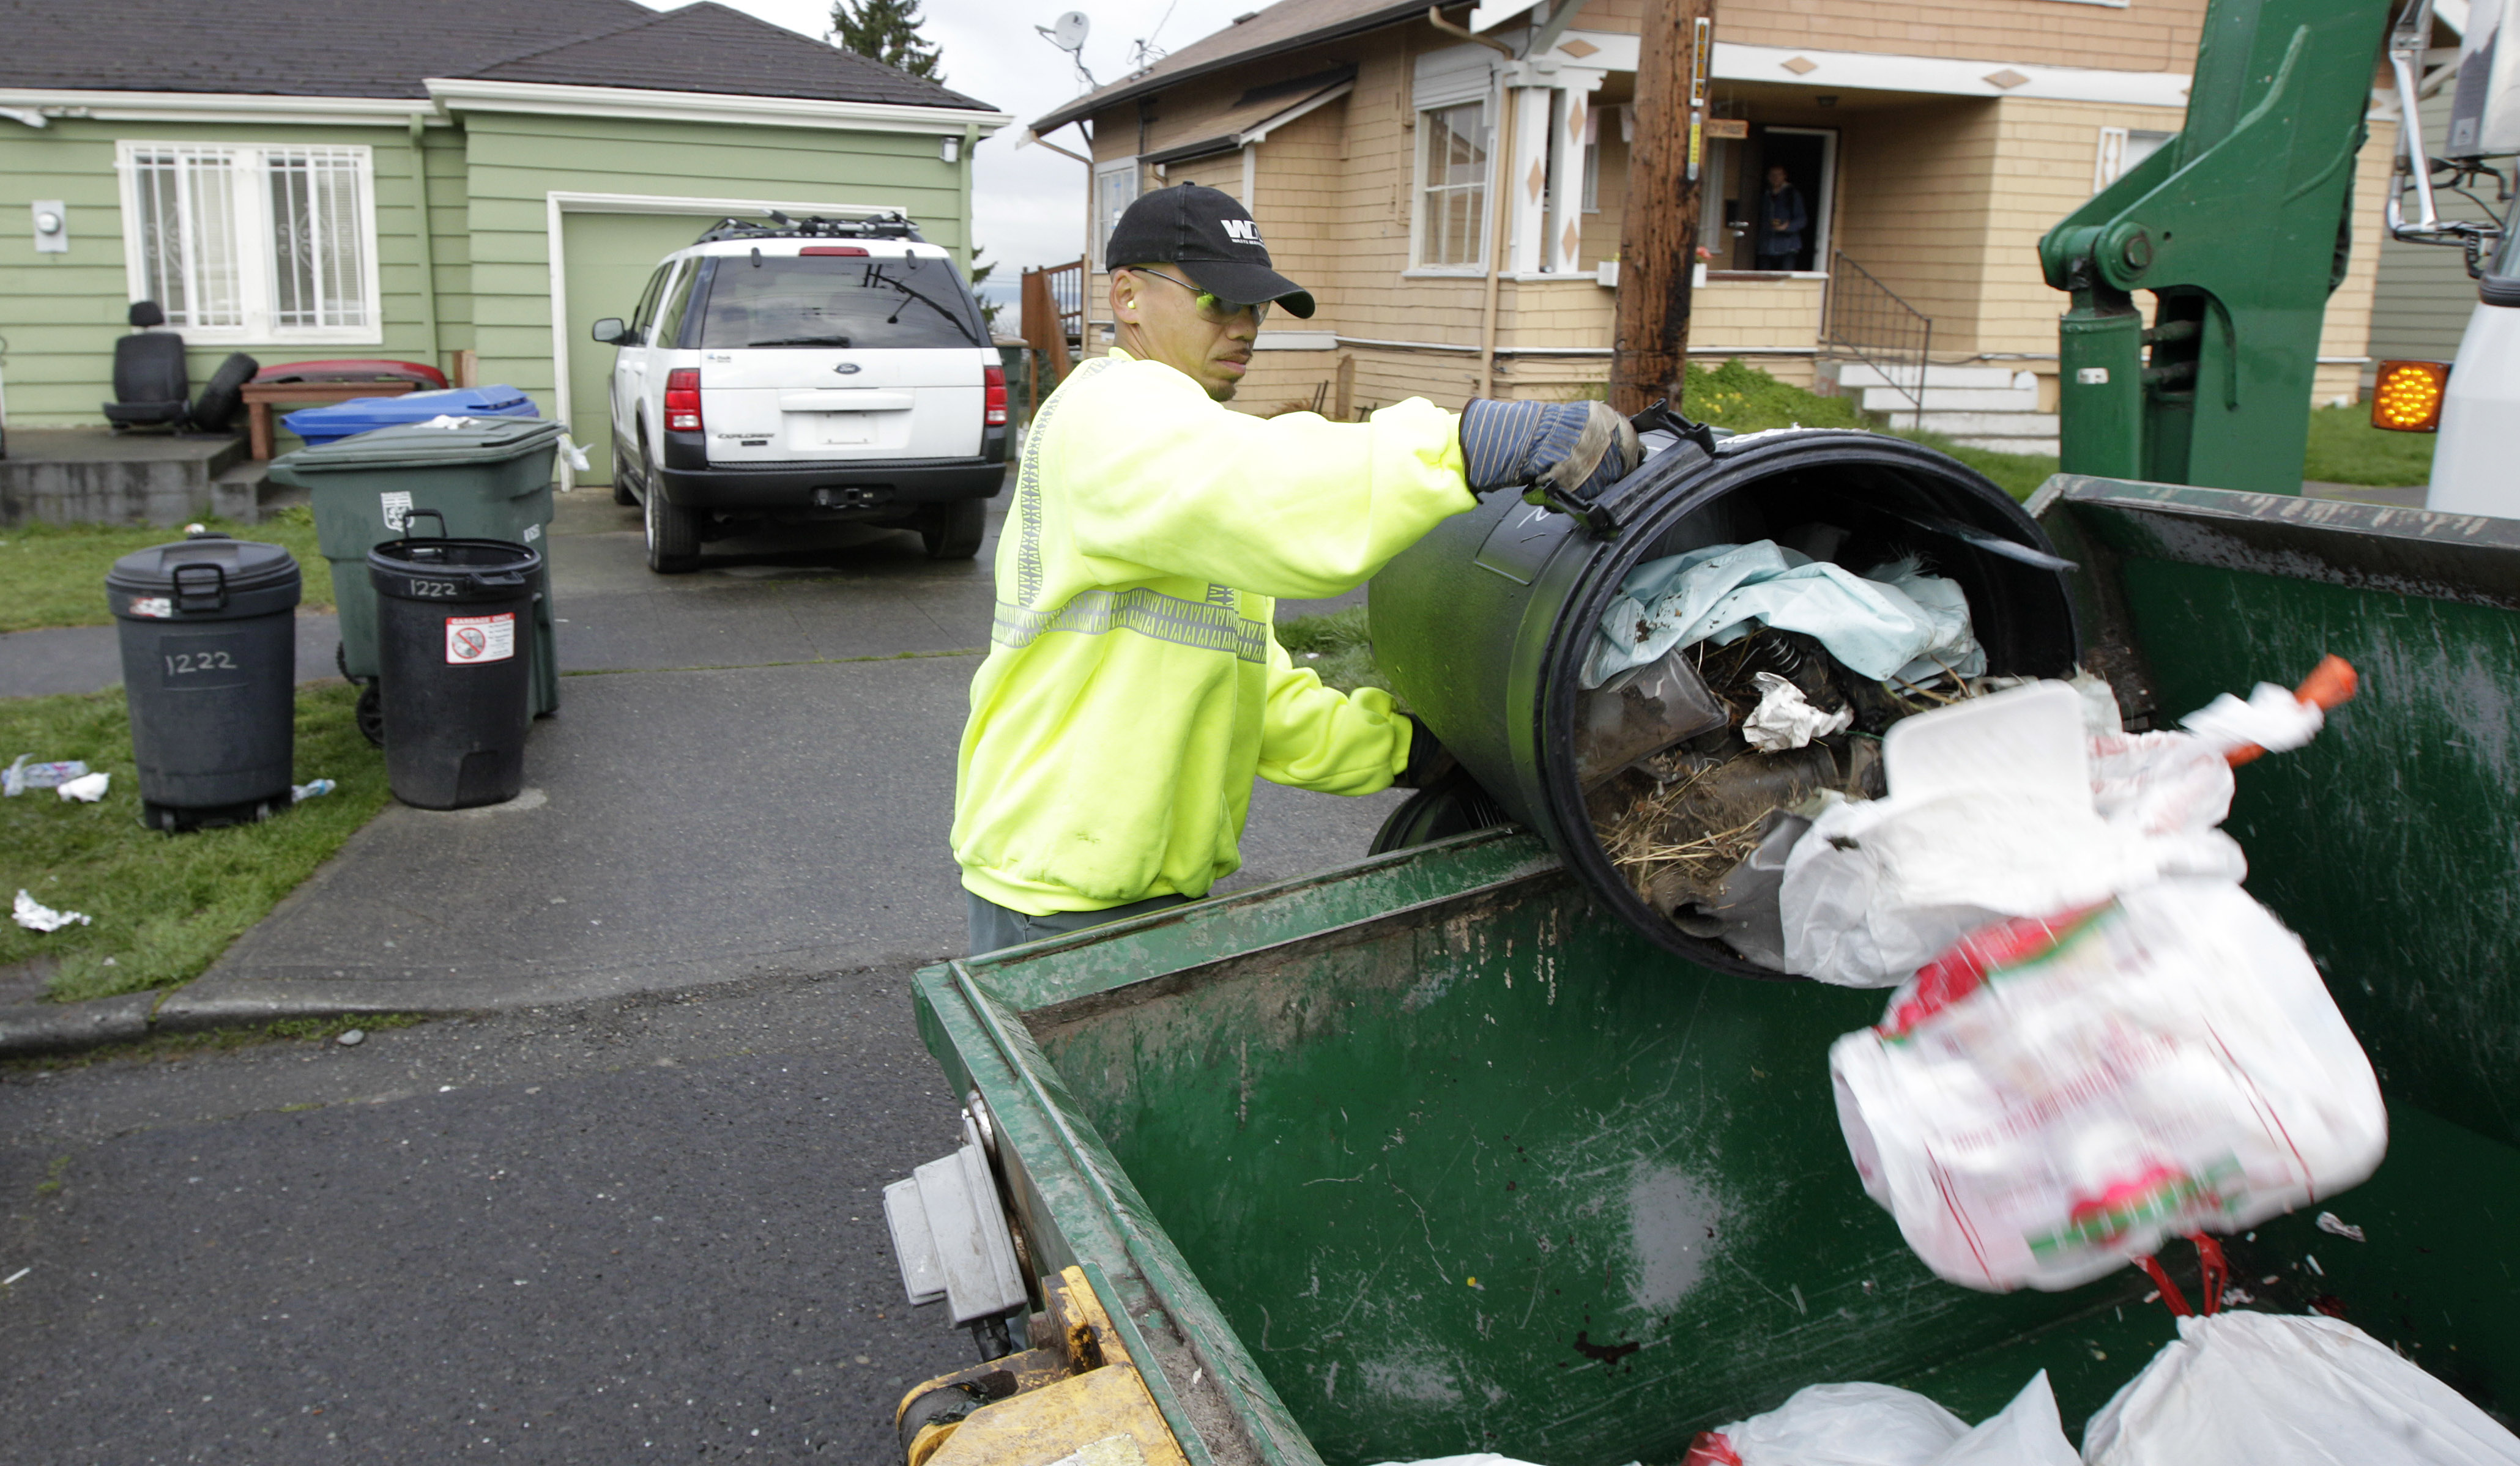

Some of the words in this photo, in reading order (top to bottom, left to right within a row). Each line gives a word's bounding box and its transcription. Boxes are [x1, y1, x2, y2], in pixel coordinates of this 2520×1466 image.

[411, 579, 458, 597] 1222
[450, 616, 490, 625] GARBAGE
[165, 651, 238, 676] 1222
